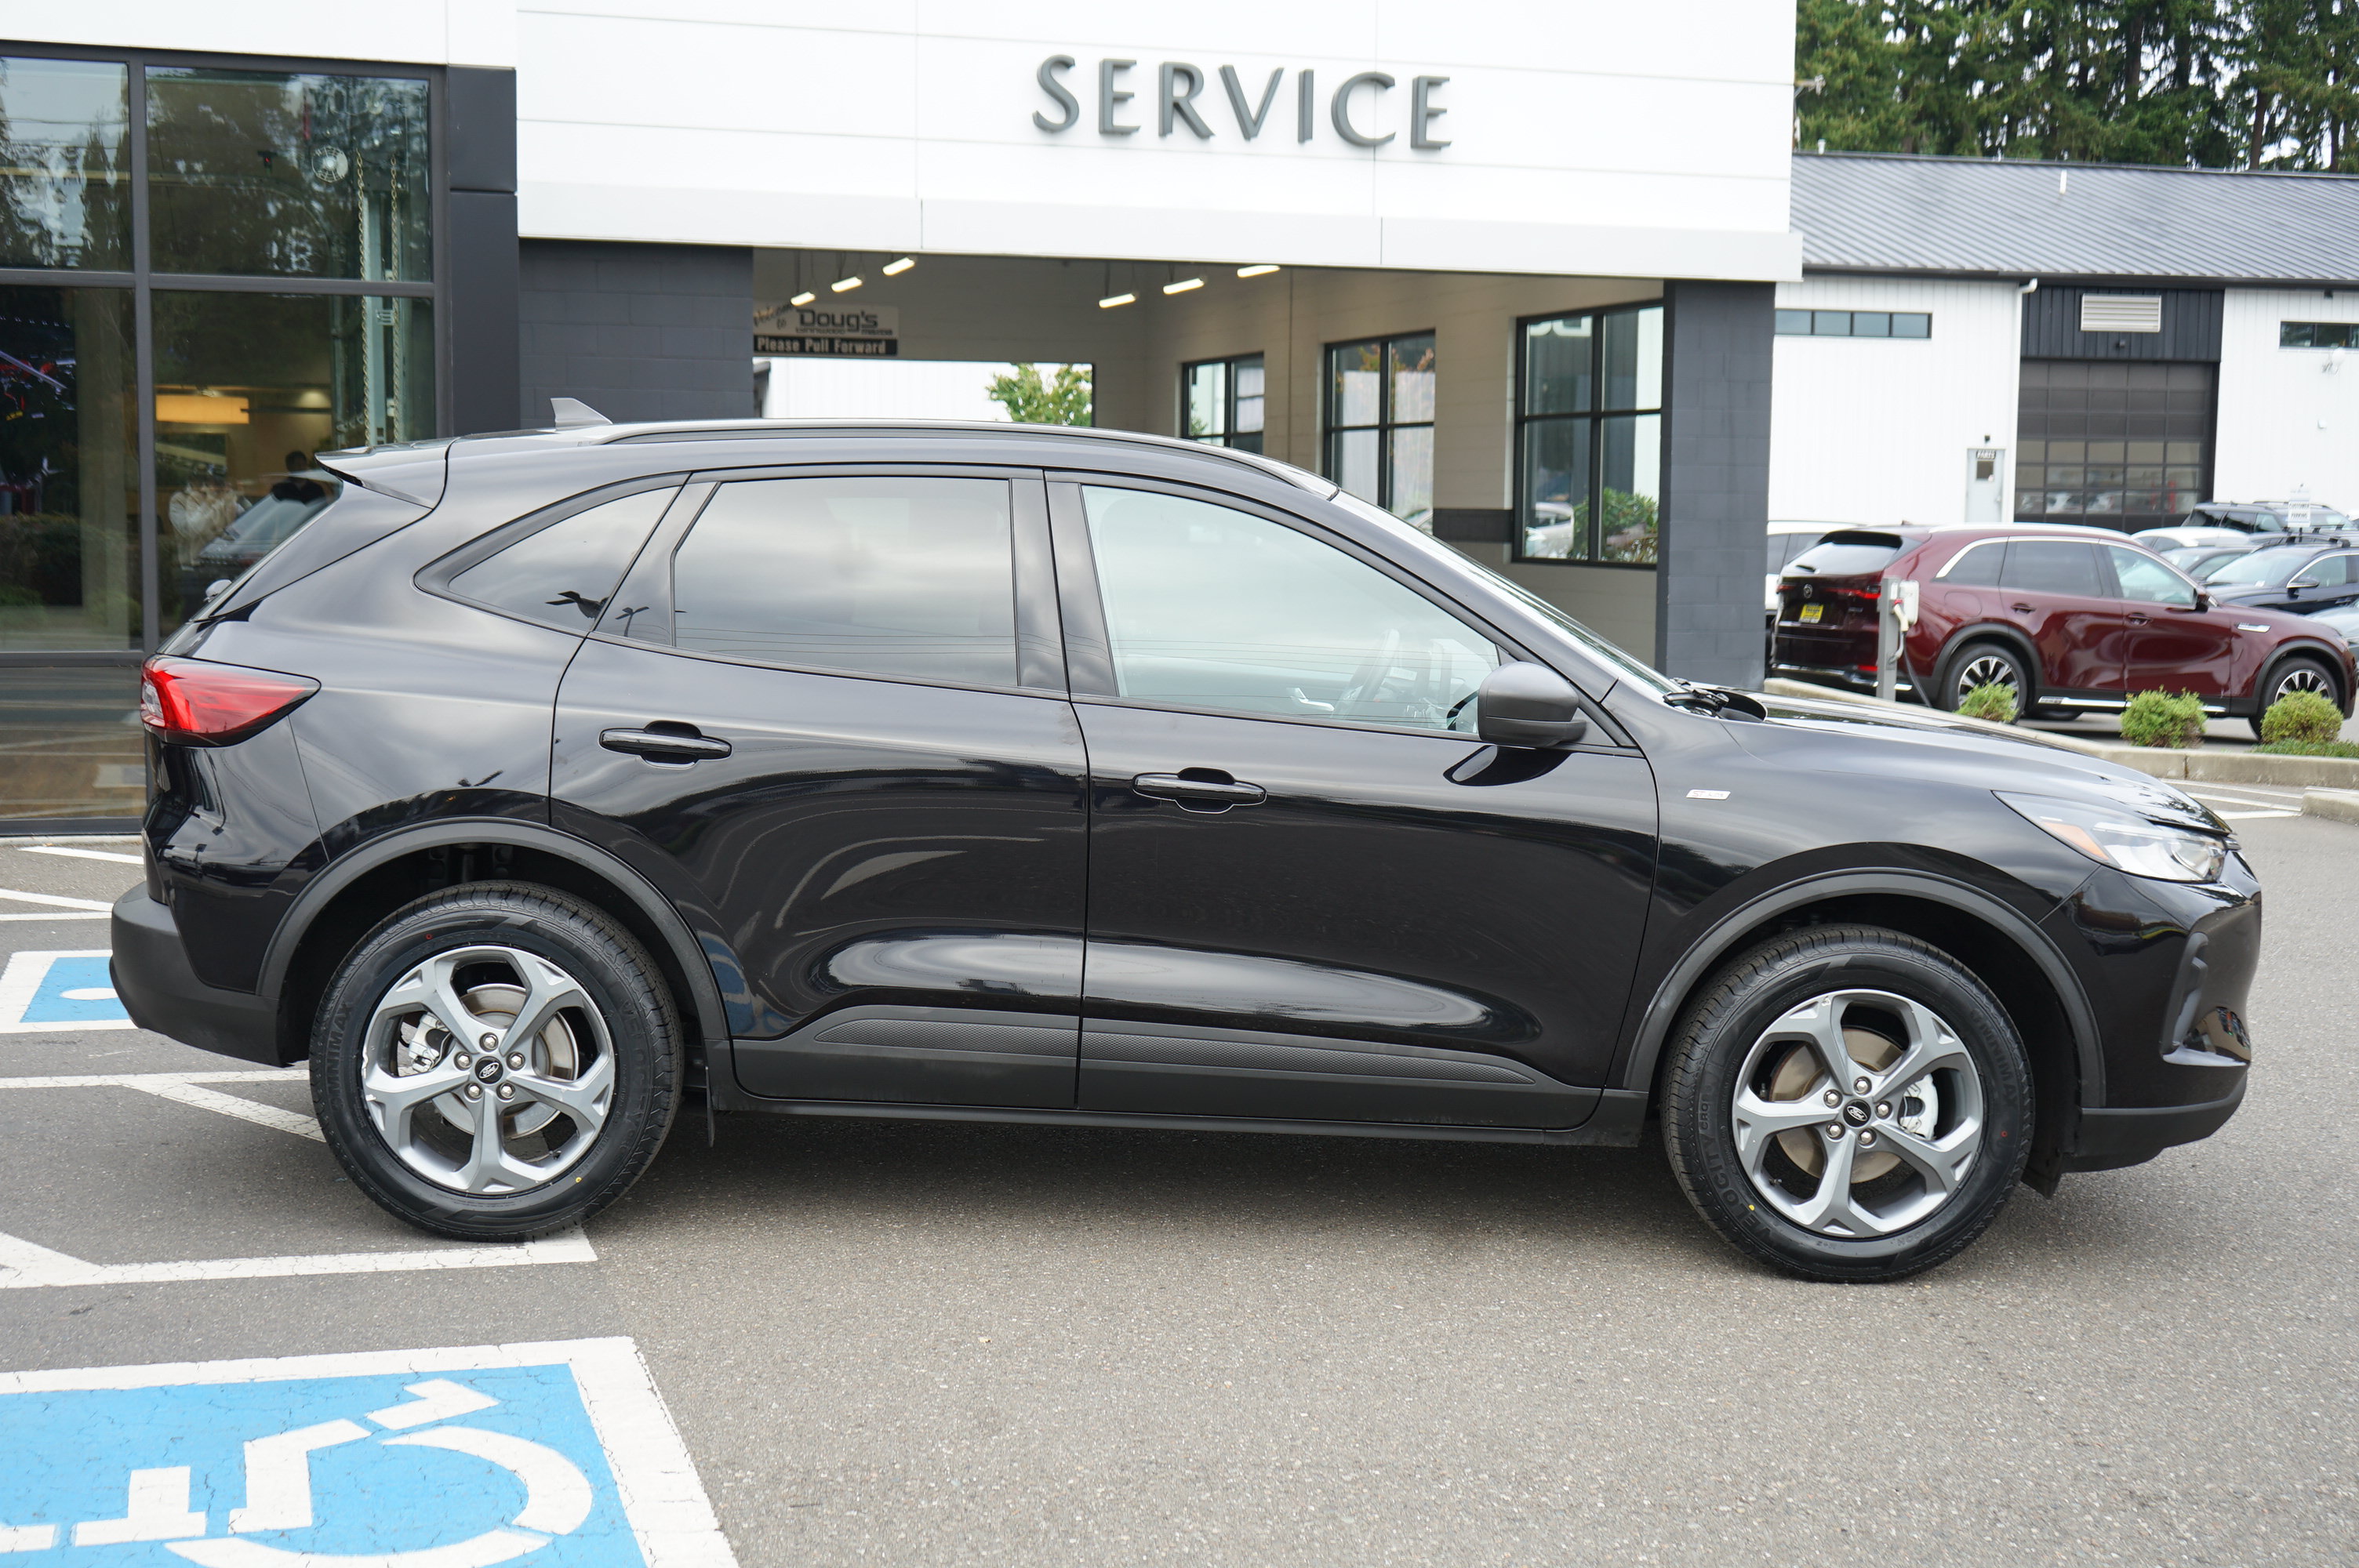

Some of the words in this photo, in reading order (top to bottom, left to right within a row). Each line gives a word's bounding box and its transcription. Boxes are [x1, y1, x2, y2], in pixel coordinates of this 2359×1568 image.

[1033, 53, 1452, 151] SERVICE
[757, 336, 800, 351] Please
[805, 337, 829, 353] Pull
[834, 338, 886, 354] Forward
[796, 309, 878, 332] Doug's
[1700, 1134, 1773, 1240] VELOCITY
